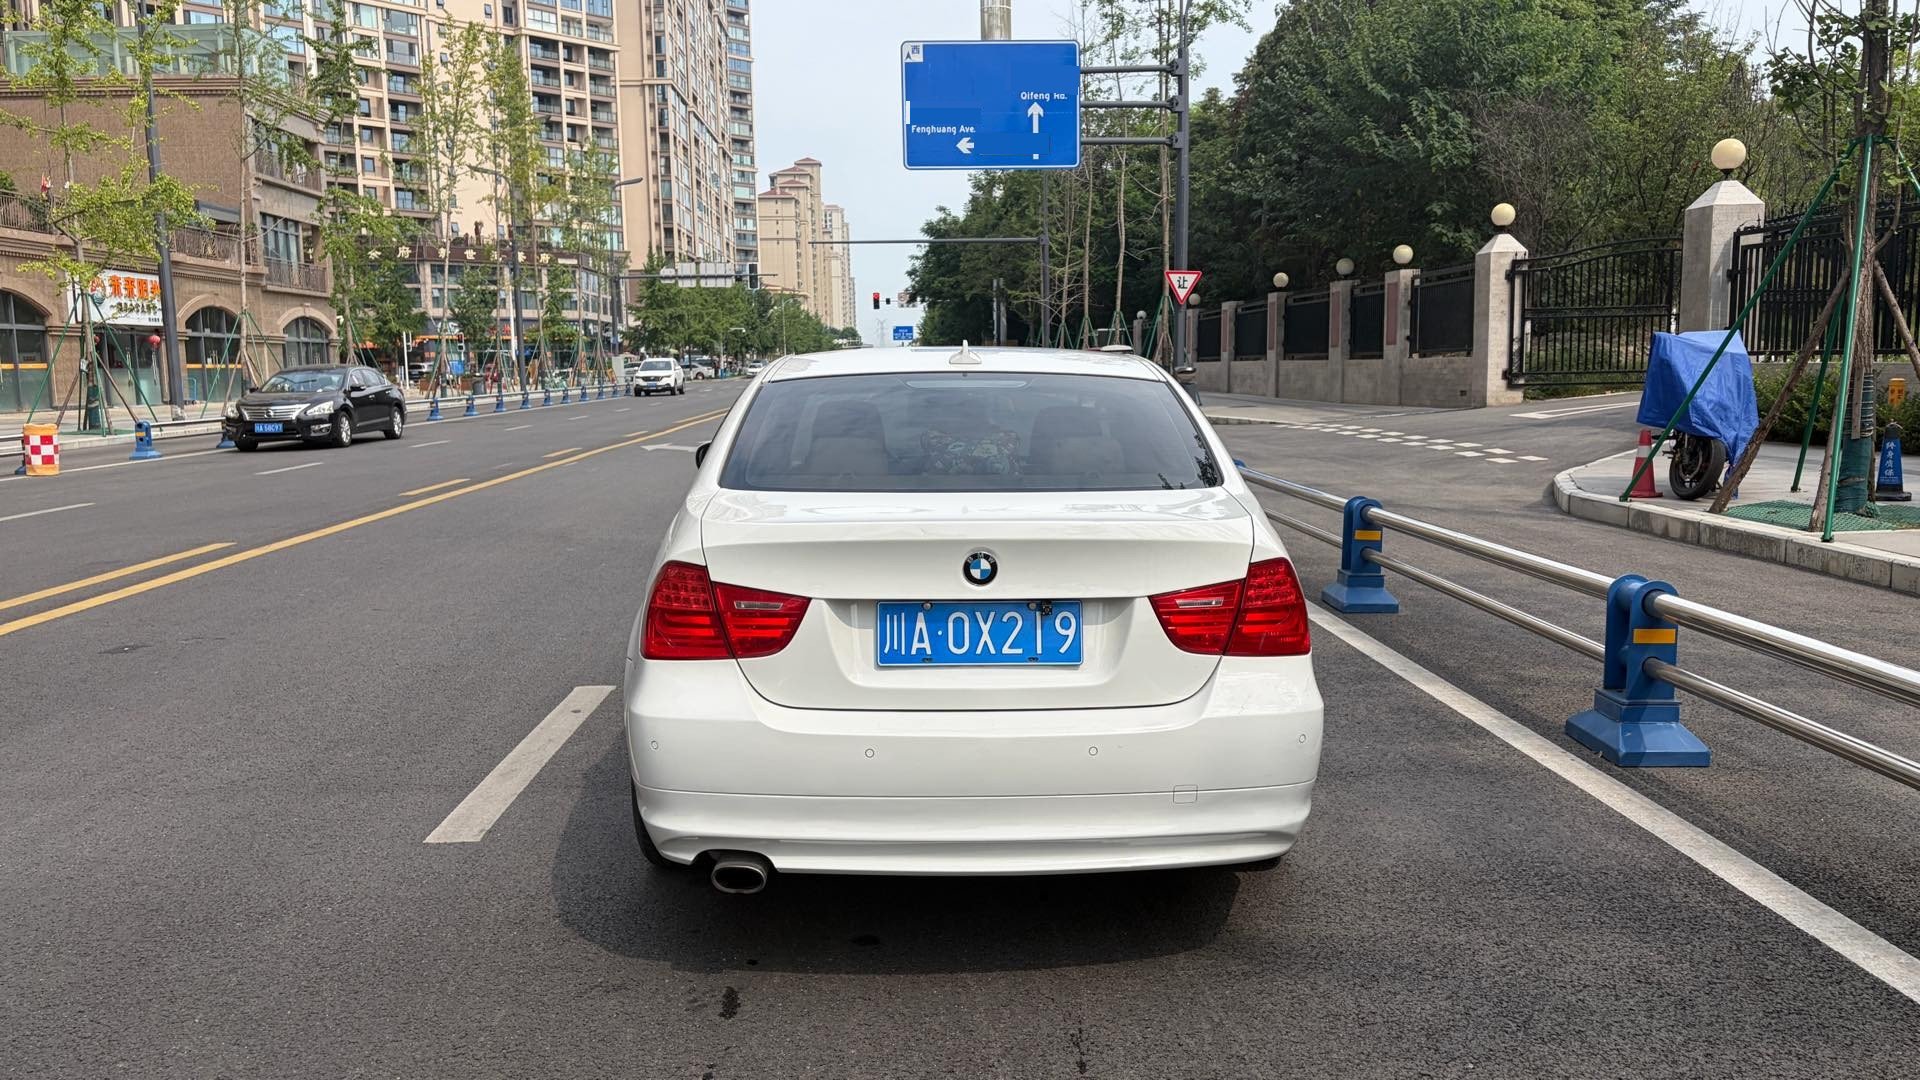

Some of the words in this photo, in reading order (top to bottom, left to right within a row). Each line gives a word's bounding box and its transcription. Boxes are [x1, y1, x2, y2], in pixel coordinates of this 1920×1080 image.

[1020, 91, 1050, 102] Qifeng
[911, 124, 957, 136] Fenghuang
[959, 124, 976, 133] Ave.
[1177, 276, 1188, 289] 让
